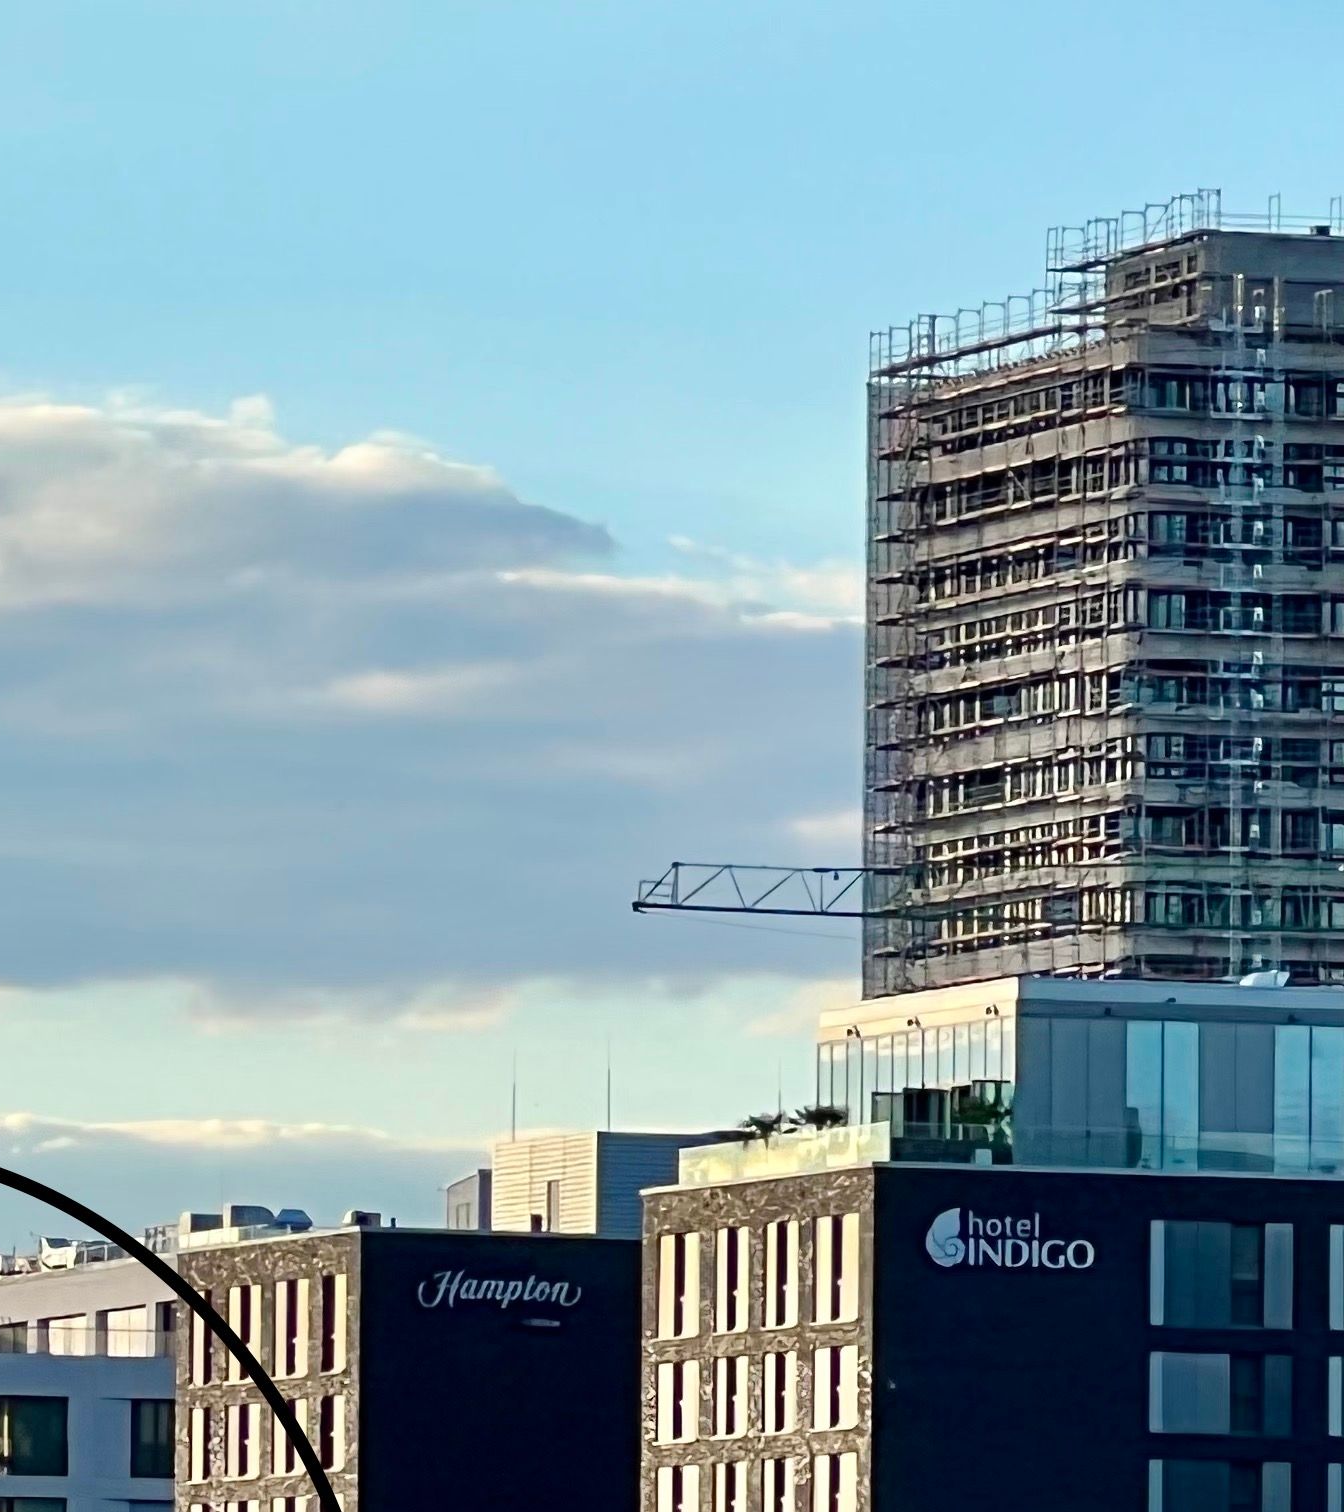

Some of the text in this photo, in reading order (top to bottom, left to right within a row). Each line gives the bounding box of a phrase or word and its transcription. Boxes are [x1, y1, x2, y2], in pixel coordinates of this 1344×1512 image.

[968, 1209, 1040, 1238] hotel
[968, 1238, 1096, 1269] INDIGO
[417, 1269, 582, 1309] Hampton
